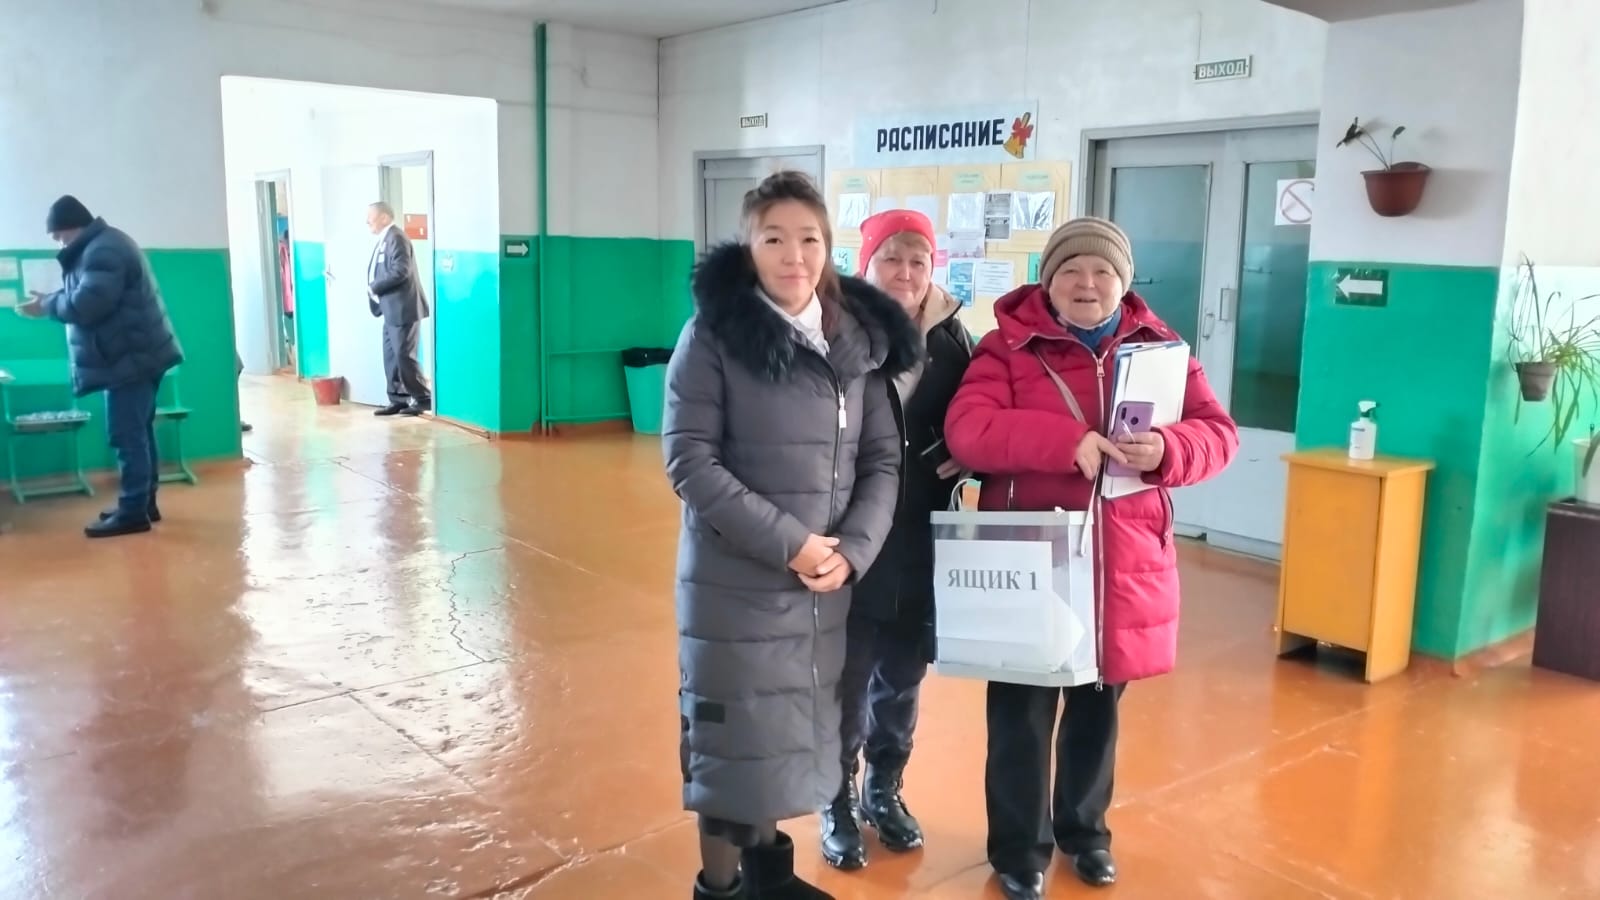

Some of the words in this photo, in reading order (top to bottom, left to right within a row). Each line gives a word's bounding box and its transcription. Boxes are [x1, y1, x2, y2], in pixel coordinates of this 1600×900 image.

[1199, 61, 1245, 78] ВЫХОД
[741, 116, 764, 127] ВЫХОД
[877, 118, 1005, 152] РАСПИСАНИЕ
[947, 568, 1021, 592] ЯЩИК
[1028, 571, 1038, 591] 1
